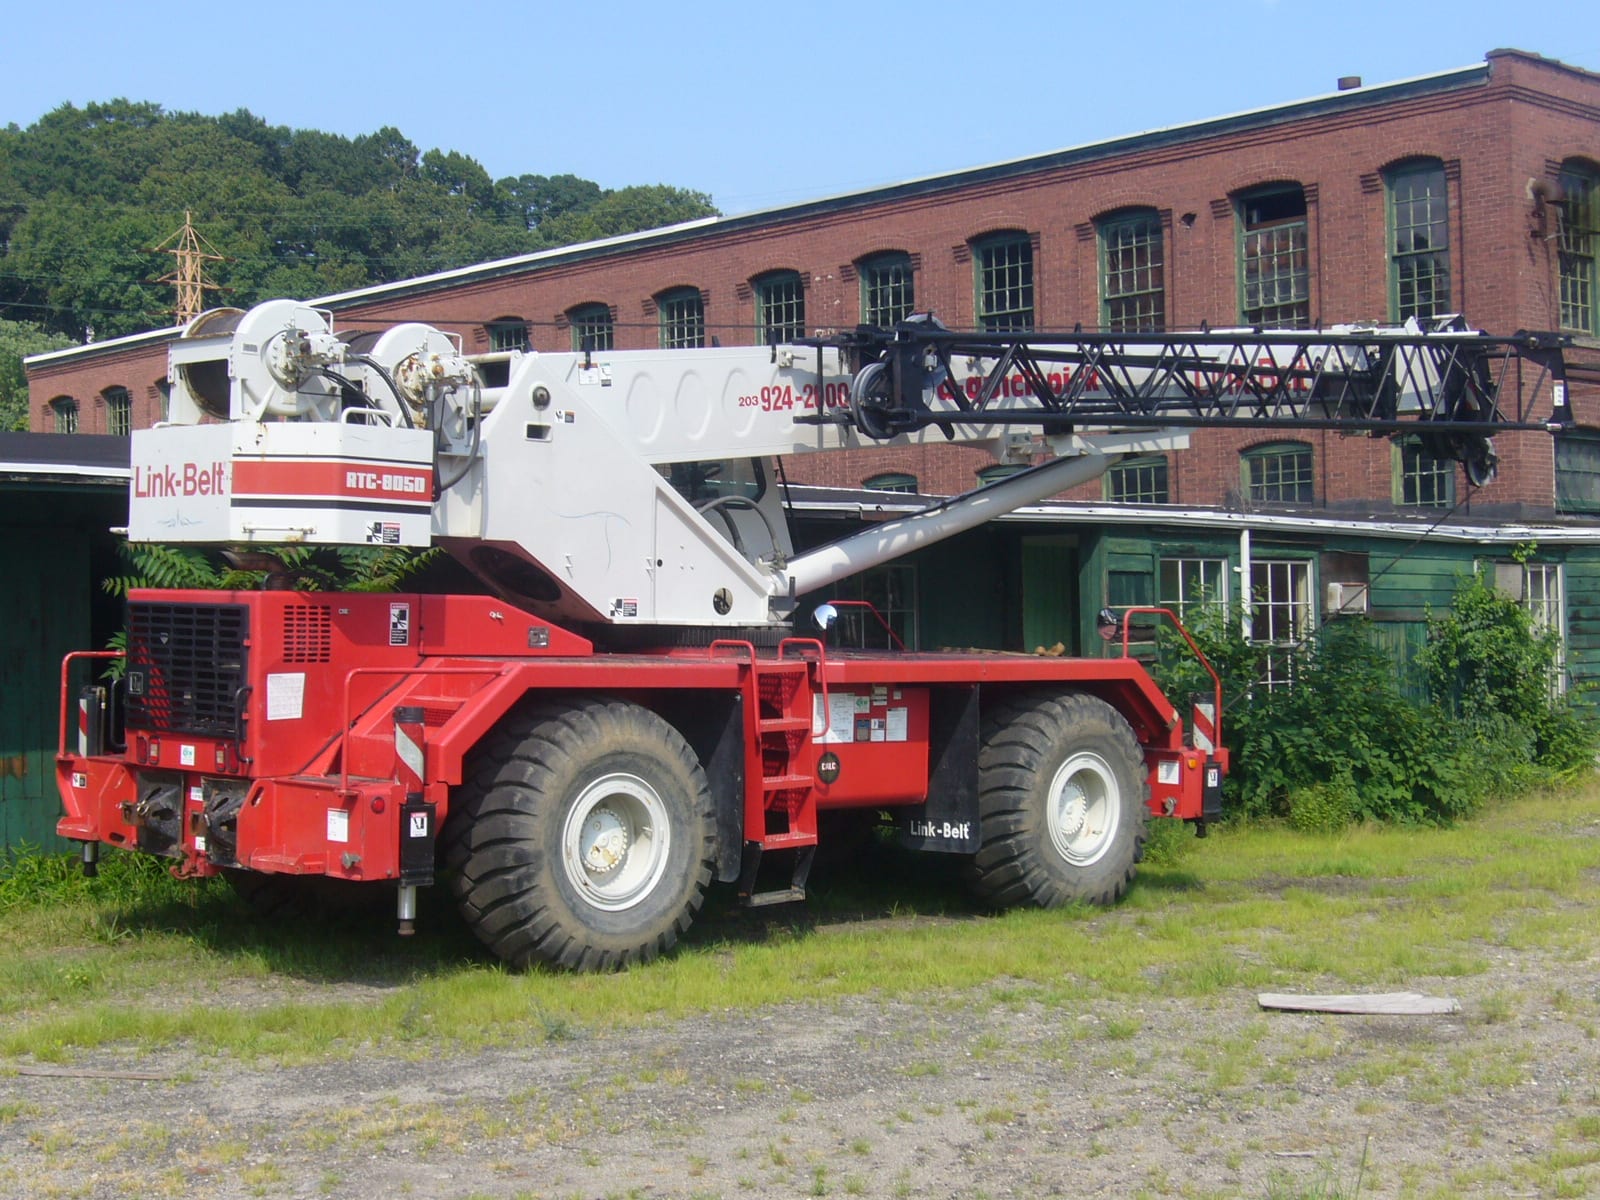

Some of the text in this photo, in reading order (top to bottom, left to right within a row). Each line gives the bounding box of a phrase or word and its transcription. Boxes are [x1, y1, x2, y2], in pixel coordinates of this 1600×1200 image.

[738, 395, 759, 407] 203
[135, 462, 224, 498] Link-Belt
[346, 471, 426, 493] RTC-8050
